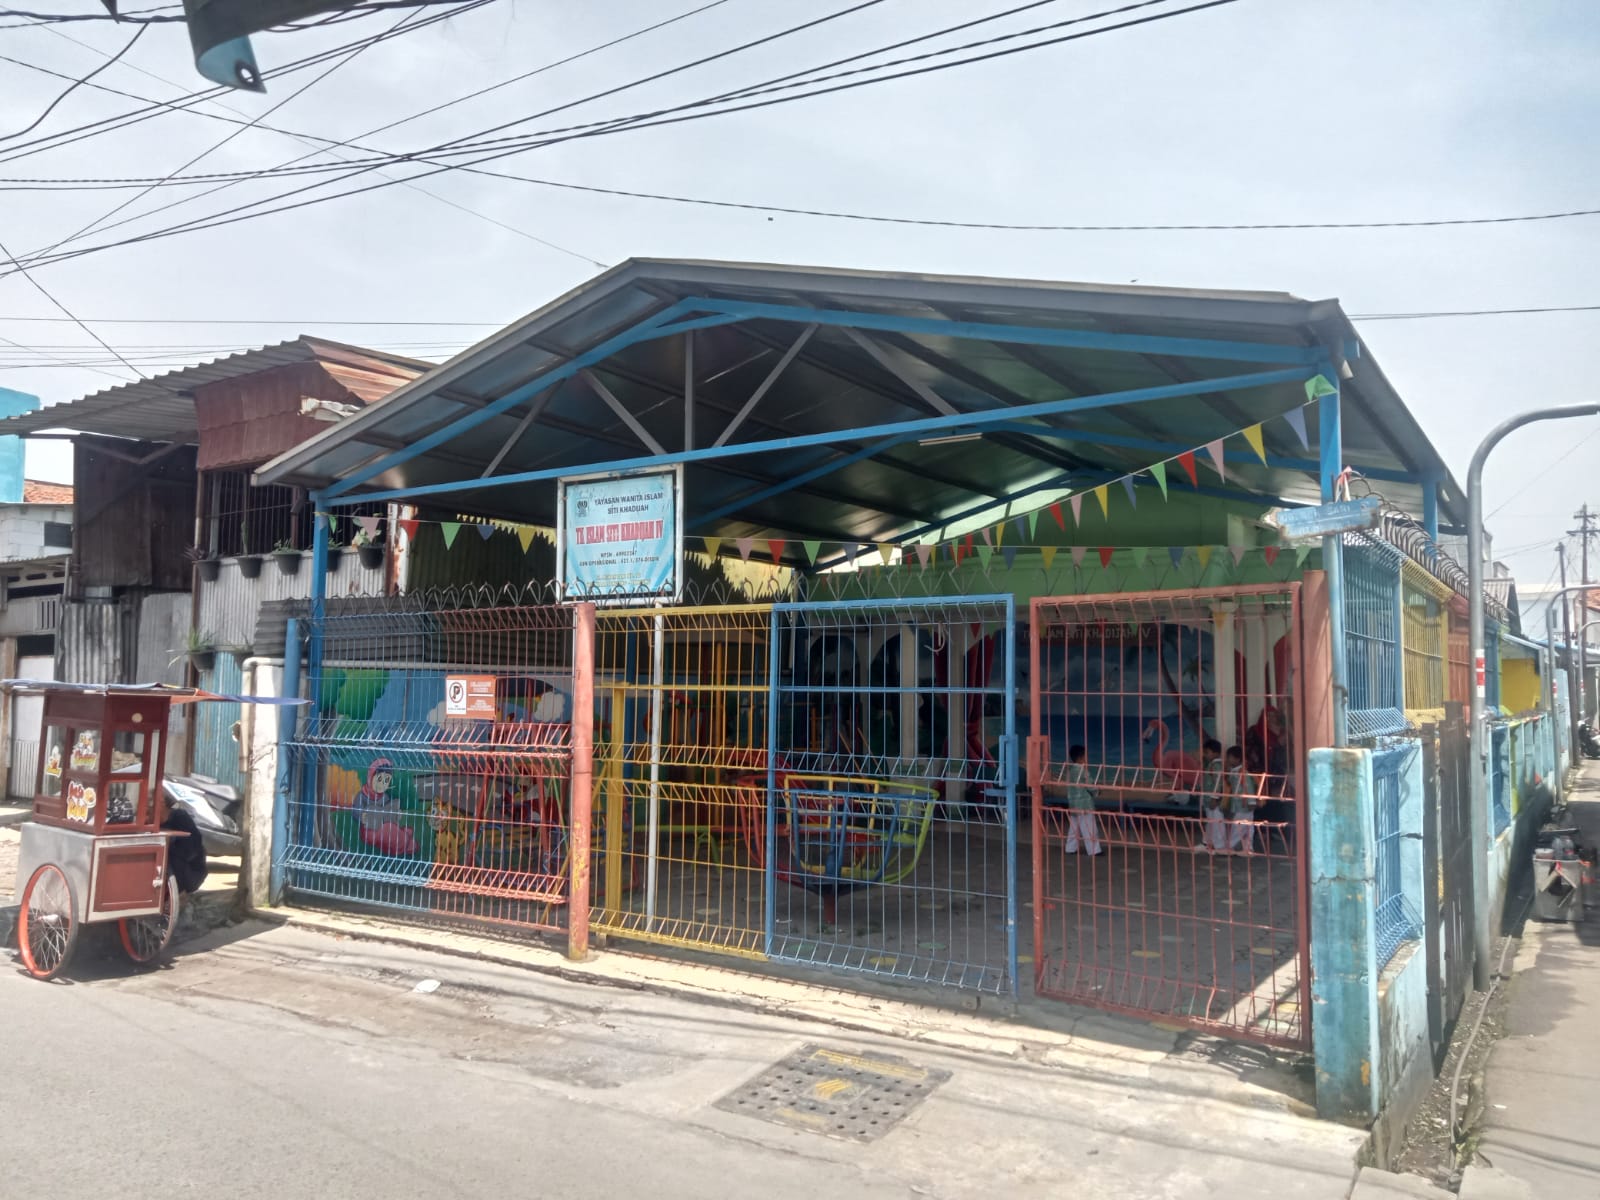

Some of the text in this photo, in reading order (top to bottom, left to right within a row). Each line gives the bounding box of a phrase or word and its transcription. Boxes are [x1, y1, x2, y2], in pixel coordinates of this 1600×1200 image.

[595, 492, 663, 505] YAYASAN WANITA ISLAM
[607, 507, 619, 515] SITI
[586, 525, 605, 544] ISLAM
[606, 524, 619, 542] SITI
